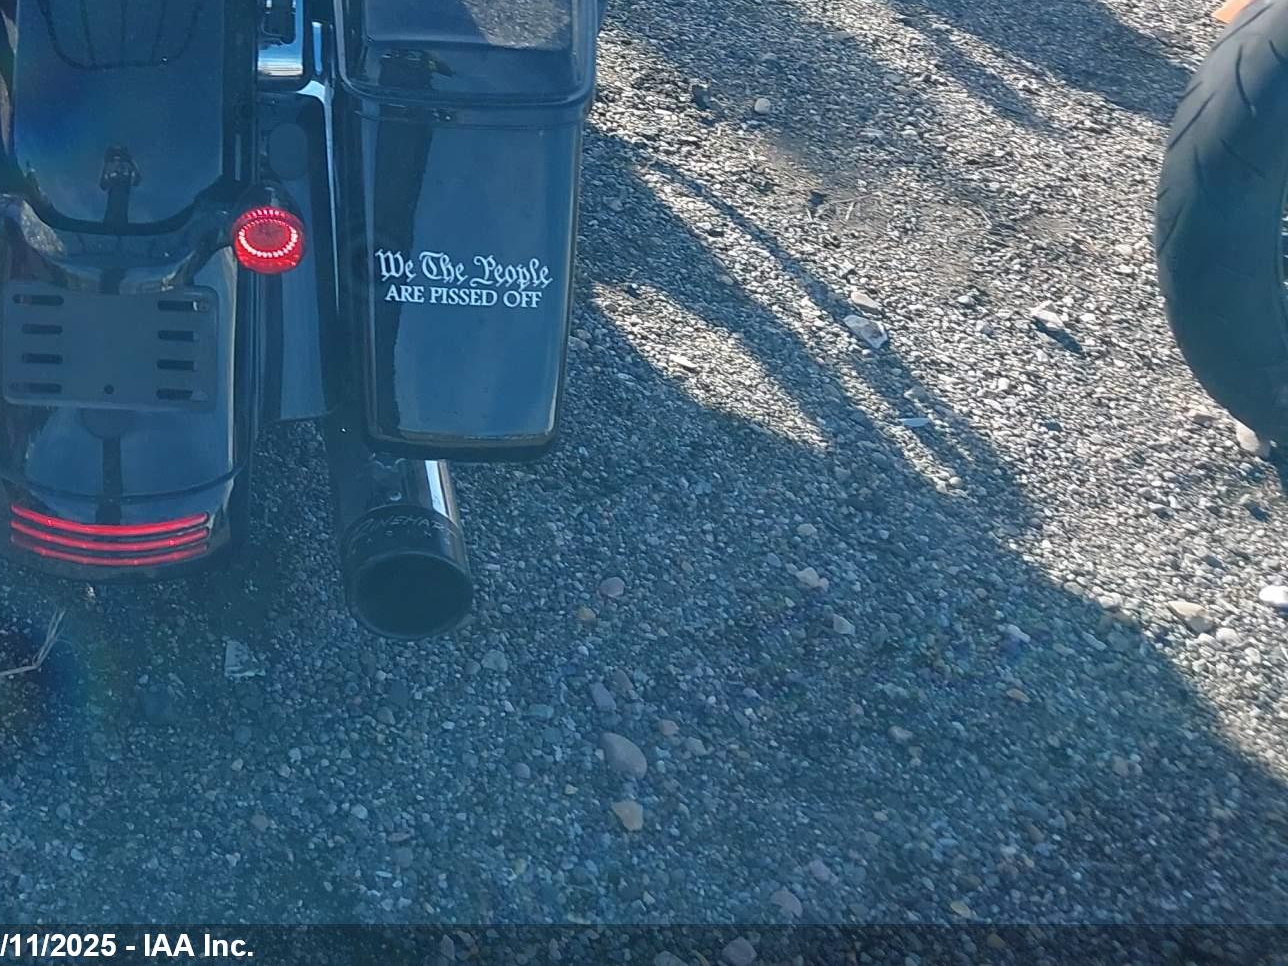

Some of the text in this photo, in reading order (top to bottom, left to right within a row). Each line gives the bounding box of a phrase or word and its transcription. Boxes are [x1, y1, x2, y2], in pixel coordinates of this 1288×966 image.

[374, 248, 553, 291] We The People
[385, 284, 543, 308] ARE PISSED OFF
